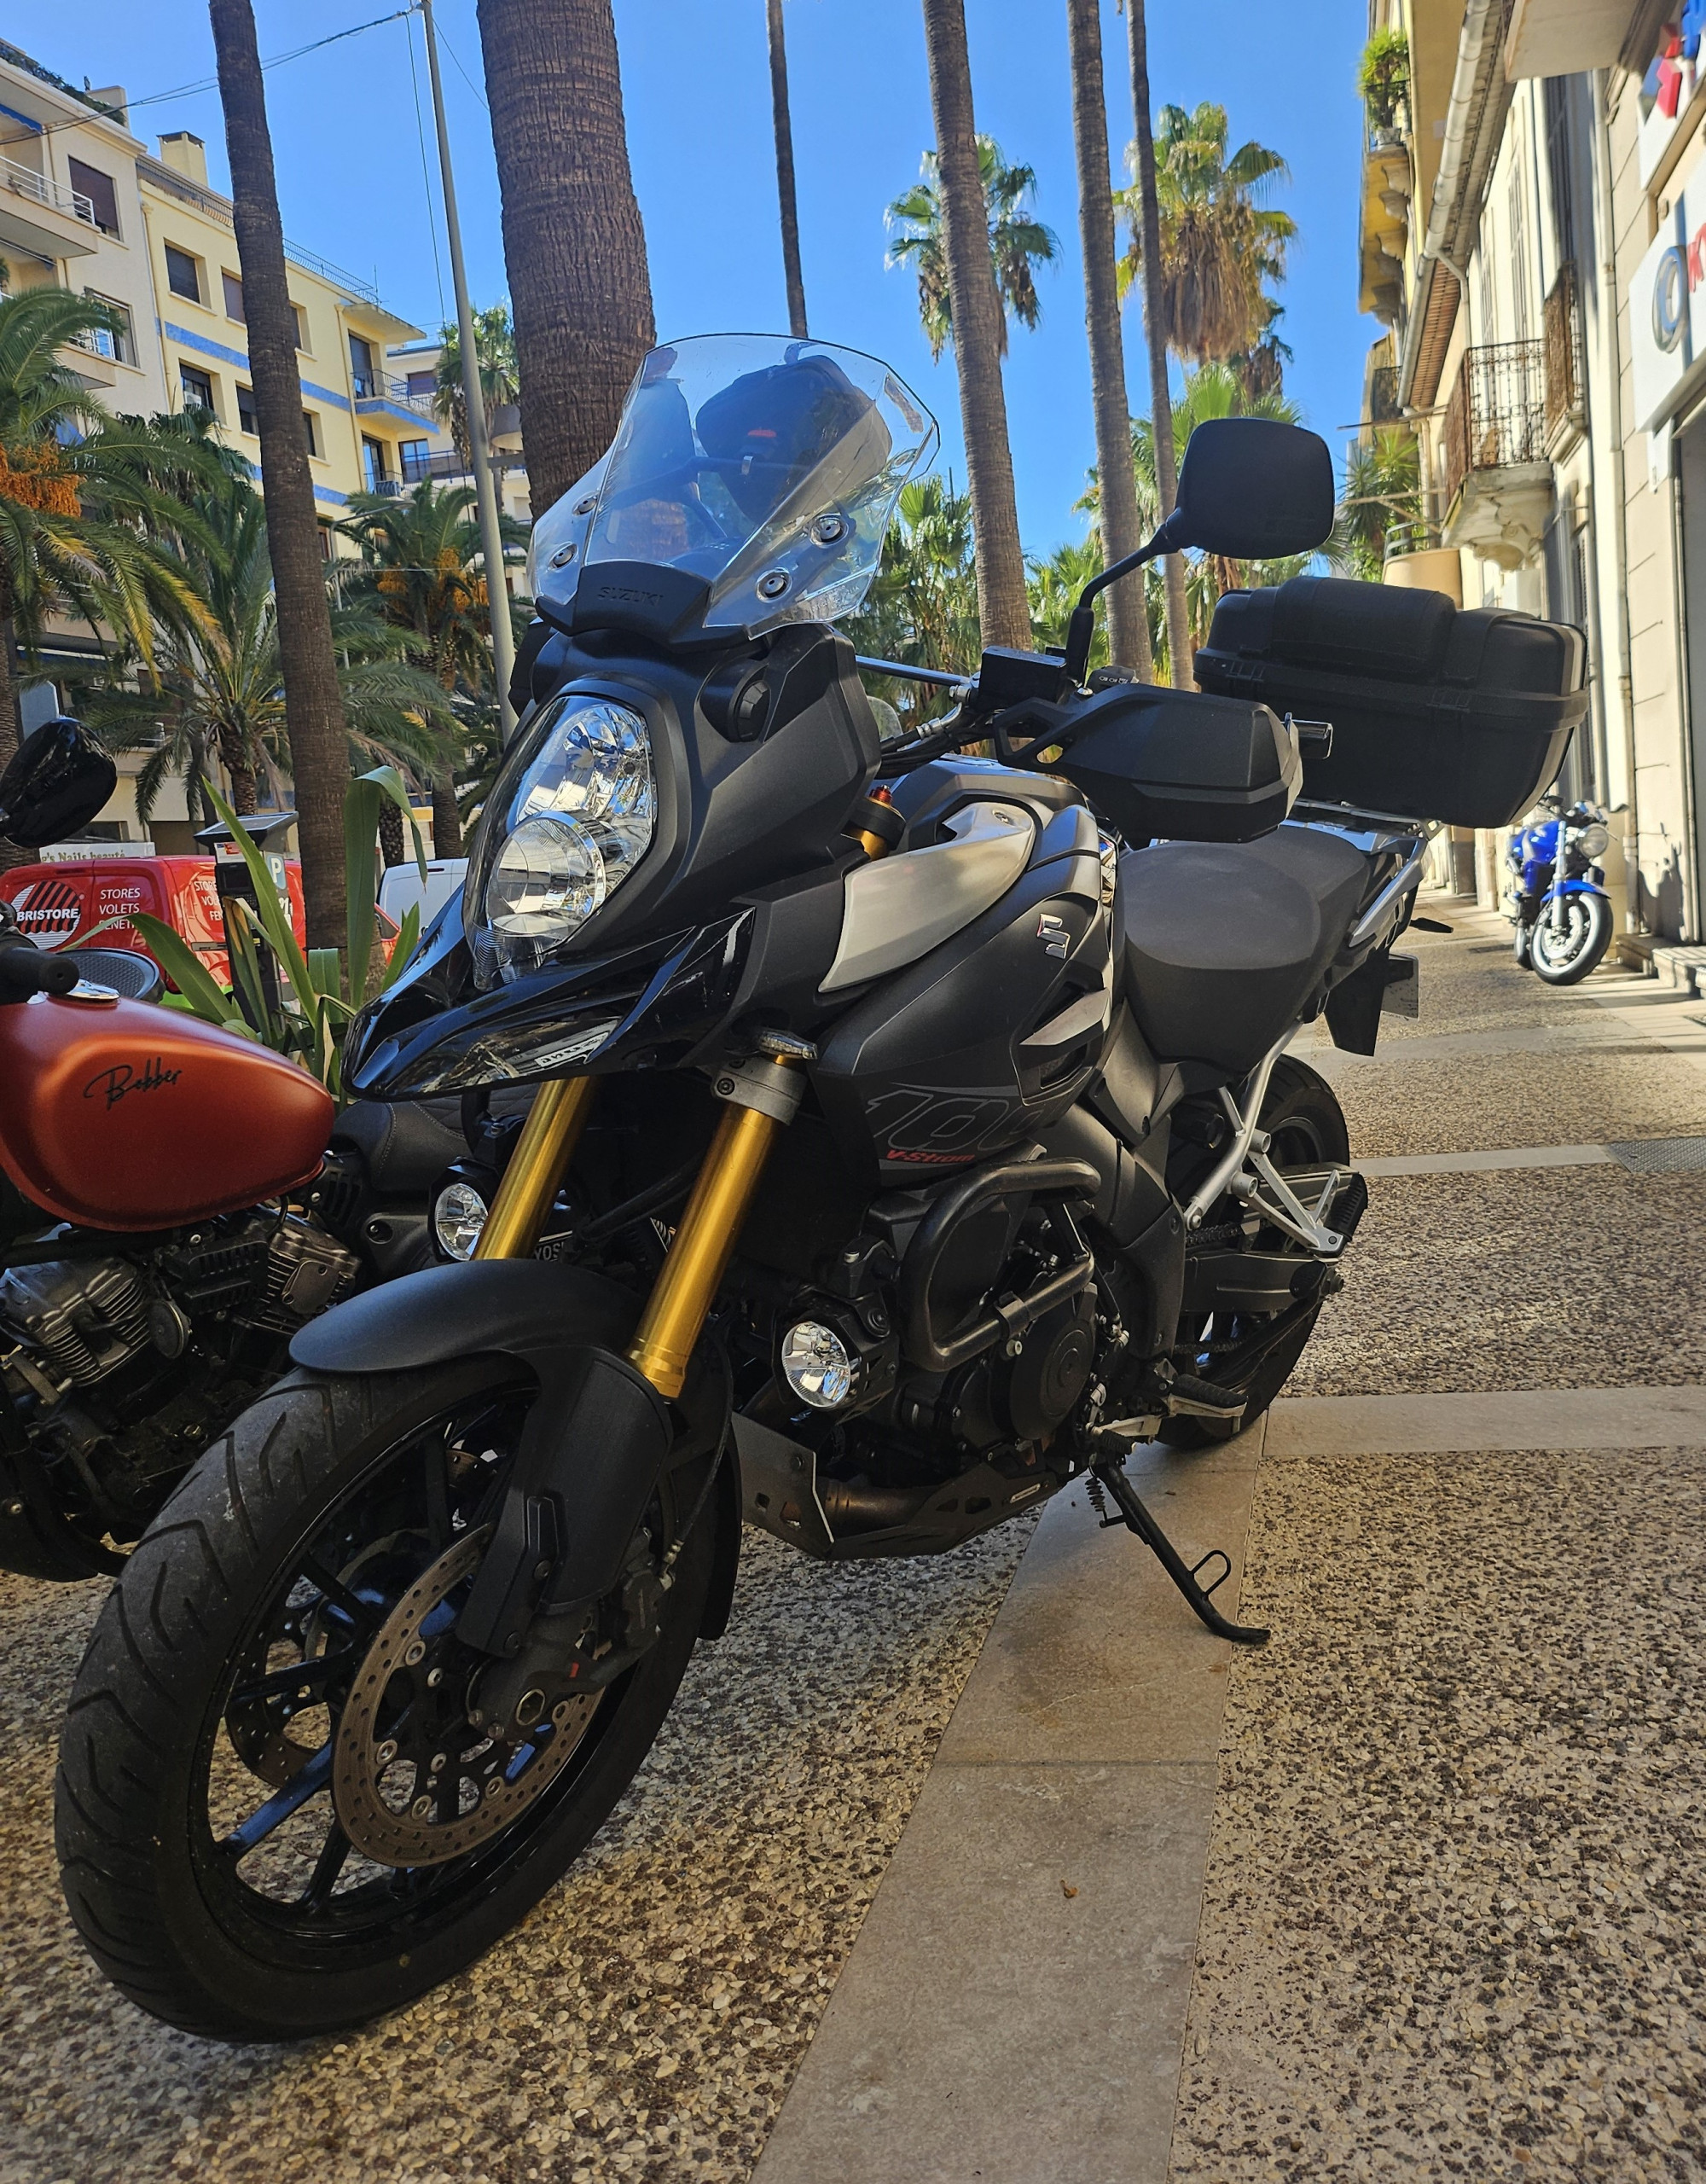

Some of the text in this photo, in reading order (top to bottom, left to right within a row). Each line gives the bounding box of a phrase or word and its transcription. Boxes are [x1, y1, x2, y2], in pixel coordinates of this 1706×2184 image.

[598, 586, 664, 607] SUZUKI
[194, 880, 218, 892] STORE
[100, 887, 141, 900] STORES
[16, 908, 79, 922] BRISTORE
[99, 903, 140, 915] VOLETS
[83, 1057, 183, 1111] Bobber
